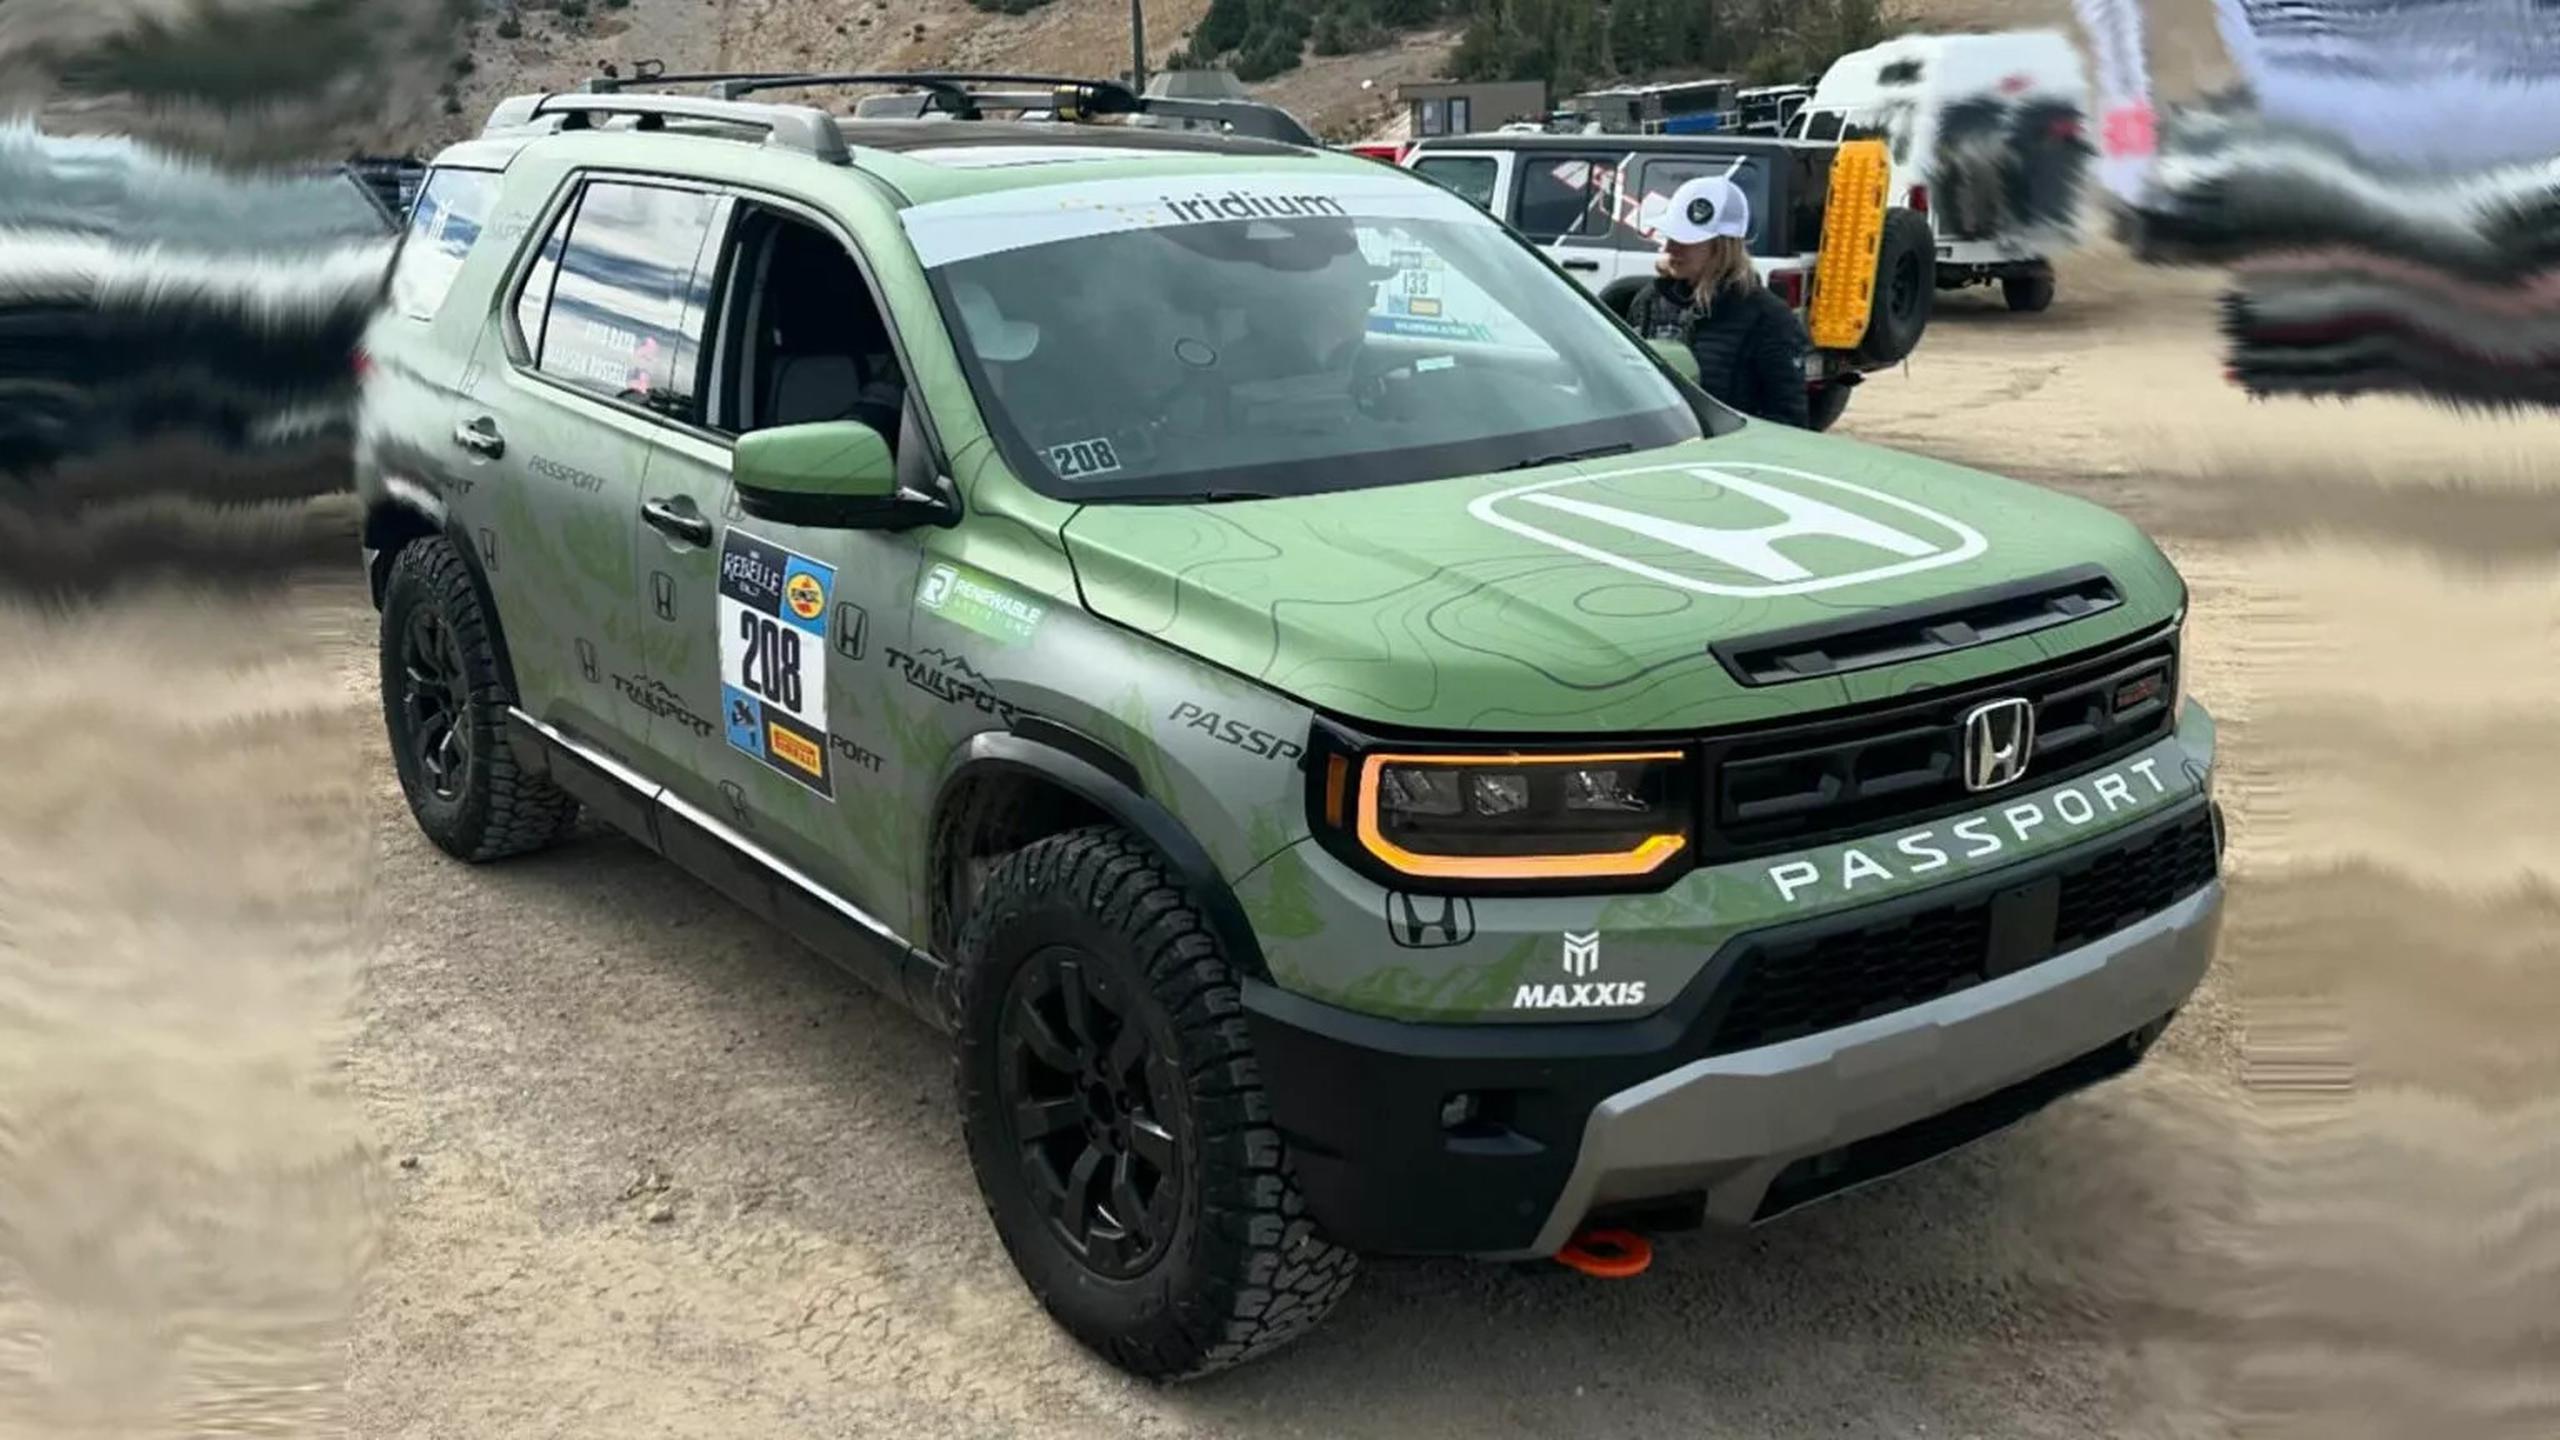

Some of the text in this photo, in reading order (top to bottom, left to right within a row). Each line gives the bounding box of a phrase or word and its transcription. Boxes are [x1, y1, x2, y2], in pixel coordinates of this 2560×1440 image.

[1160, 191, 1346, 222] iridium
[1403, 271, 1428, 294] 133
[528, 454, 606, 493] PASSPORT
[1053, 441, 1117, 476] 208
[723, 552, 780, 596] REBELLE
[741, 610, 801, 714] 208
[610, 674, 715, 738] TRAILSPORT
[1168, 701, 1308, 772] PASSP
[1767, 759, 2165, 901] PASSPORT
[1513, 981, 1646, 1008] MAXXIS
